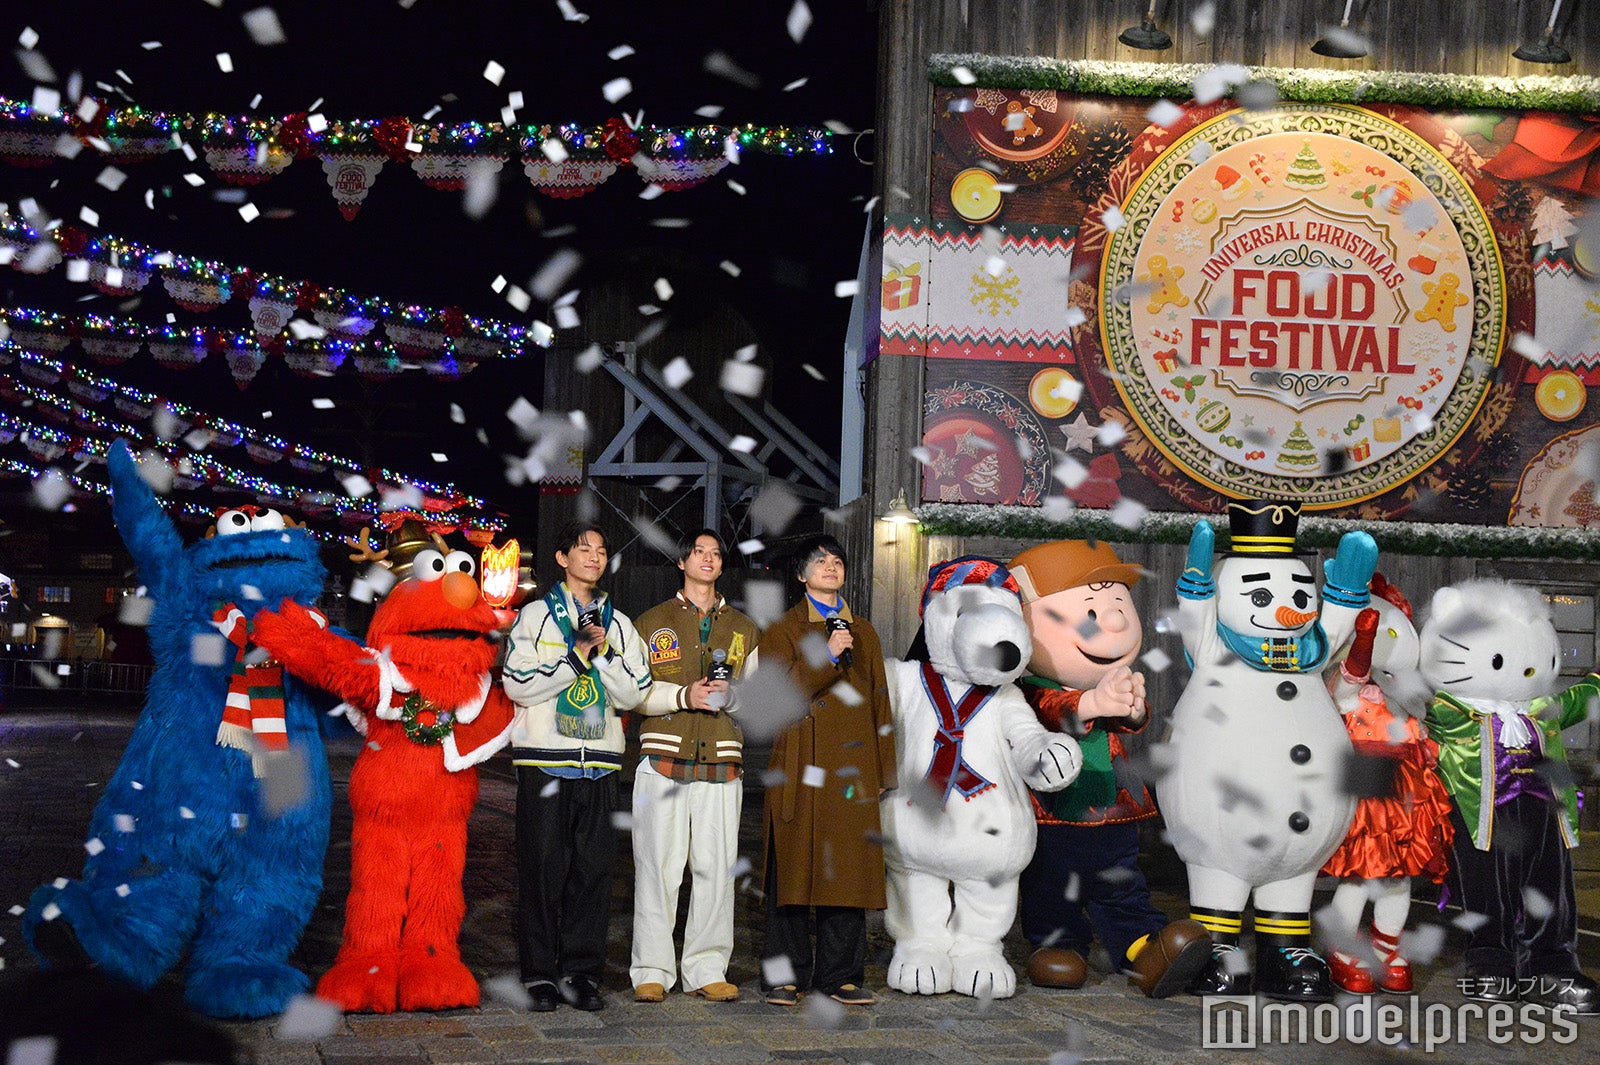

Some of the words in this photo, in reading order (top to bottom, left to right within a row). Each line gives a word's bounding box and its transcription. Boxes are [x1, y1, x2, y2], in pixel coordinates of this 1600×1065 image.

[1200, 221, 1299, 282] UNIVERSAL
[1305, 221, 1404, 289] CHRISTMAS
[1232, 269, 1375, 320] FOOD
[1191, 318, 1416, 374] FESTIVAL
[654, 650, 678, 661] LION
